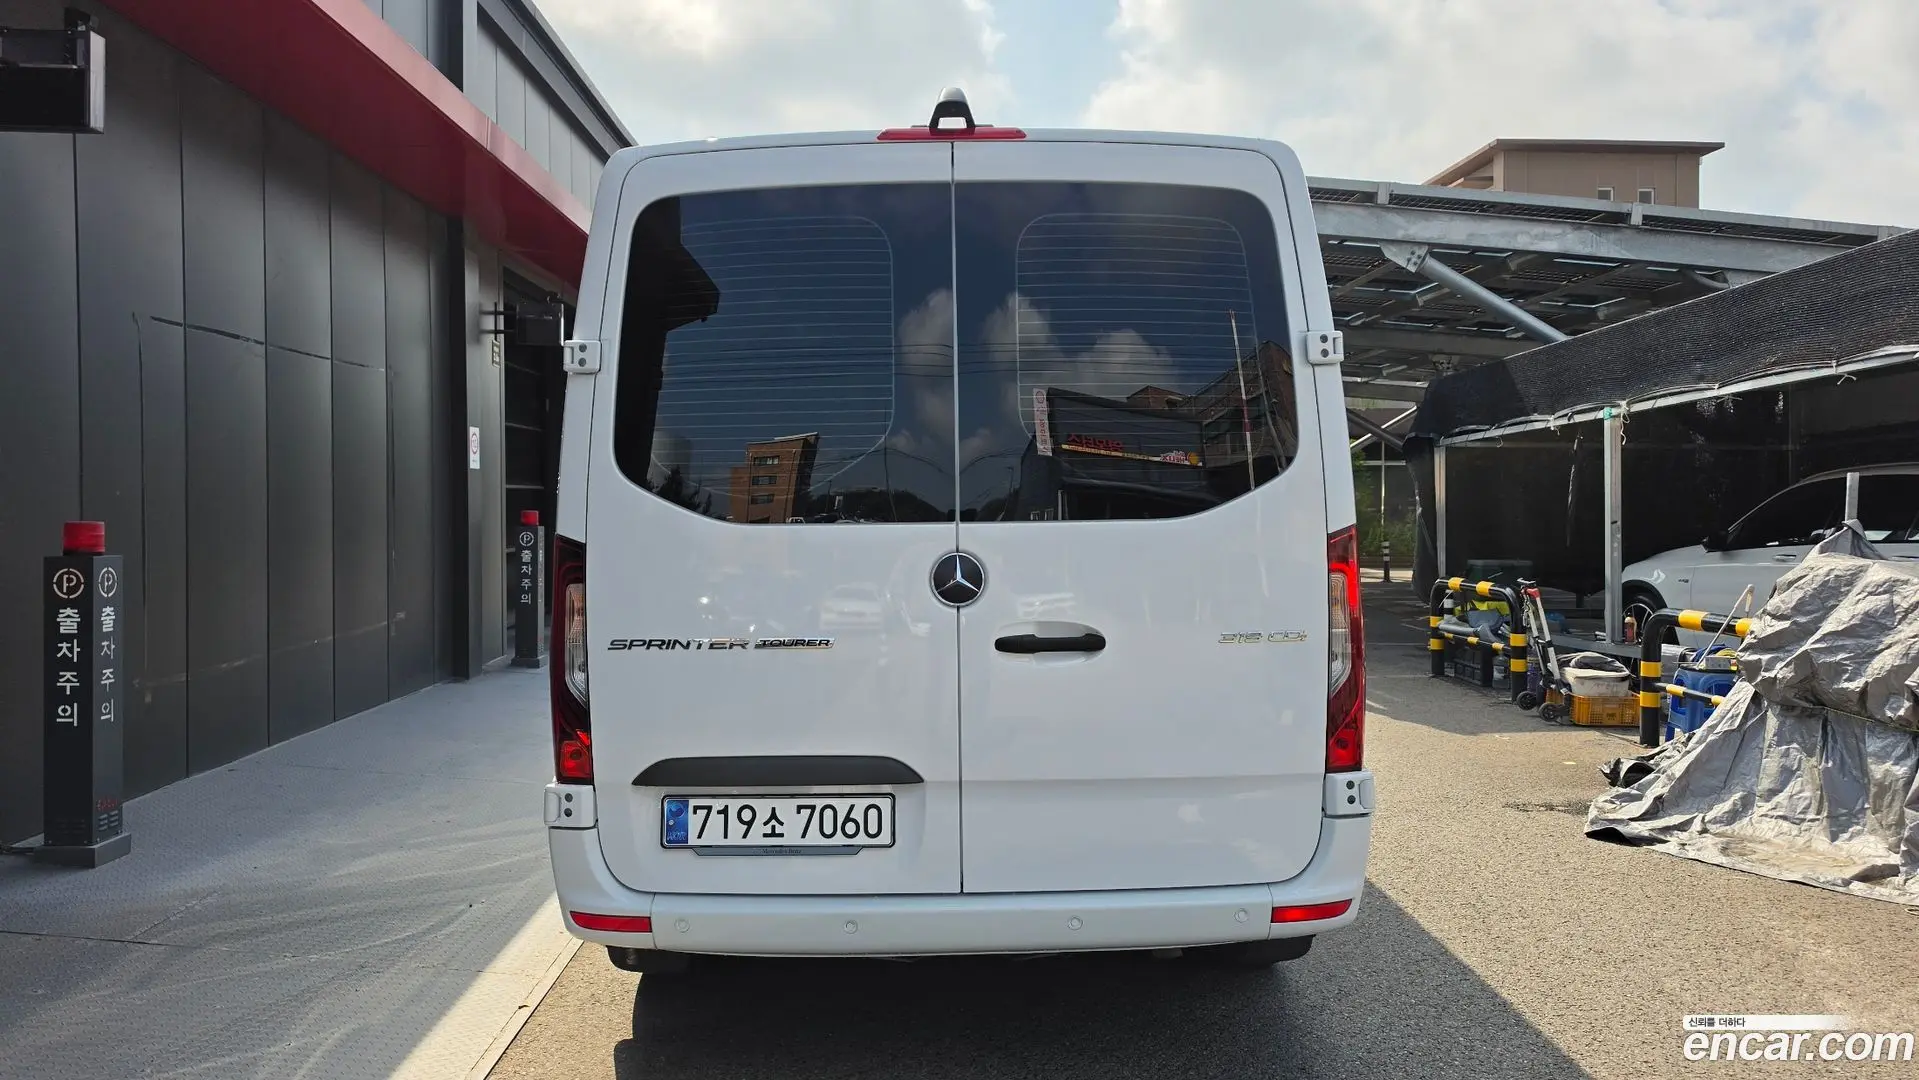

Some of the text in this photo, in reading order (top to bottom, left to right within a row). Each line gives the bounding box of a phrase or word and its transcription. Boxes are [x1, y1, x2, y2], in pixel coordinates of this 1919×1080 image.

[56, 607, 81, 727] 출차주의
[100, 605, 116, 722] 출차주의
[607, 637, 832, 650] SPRINTER TOURER
[692, 803, 883, 839] 719소 7060
